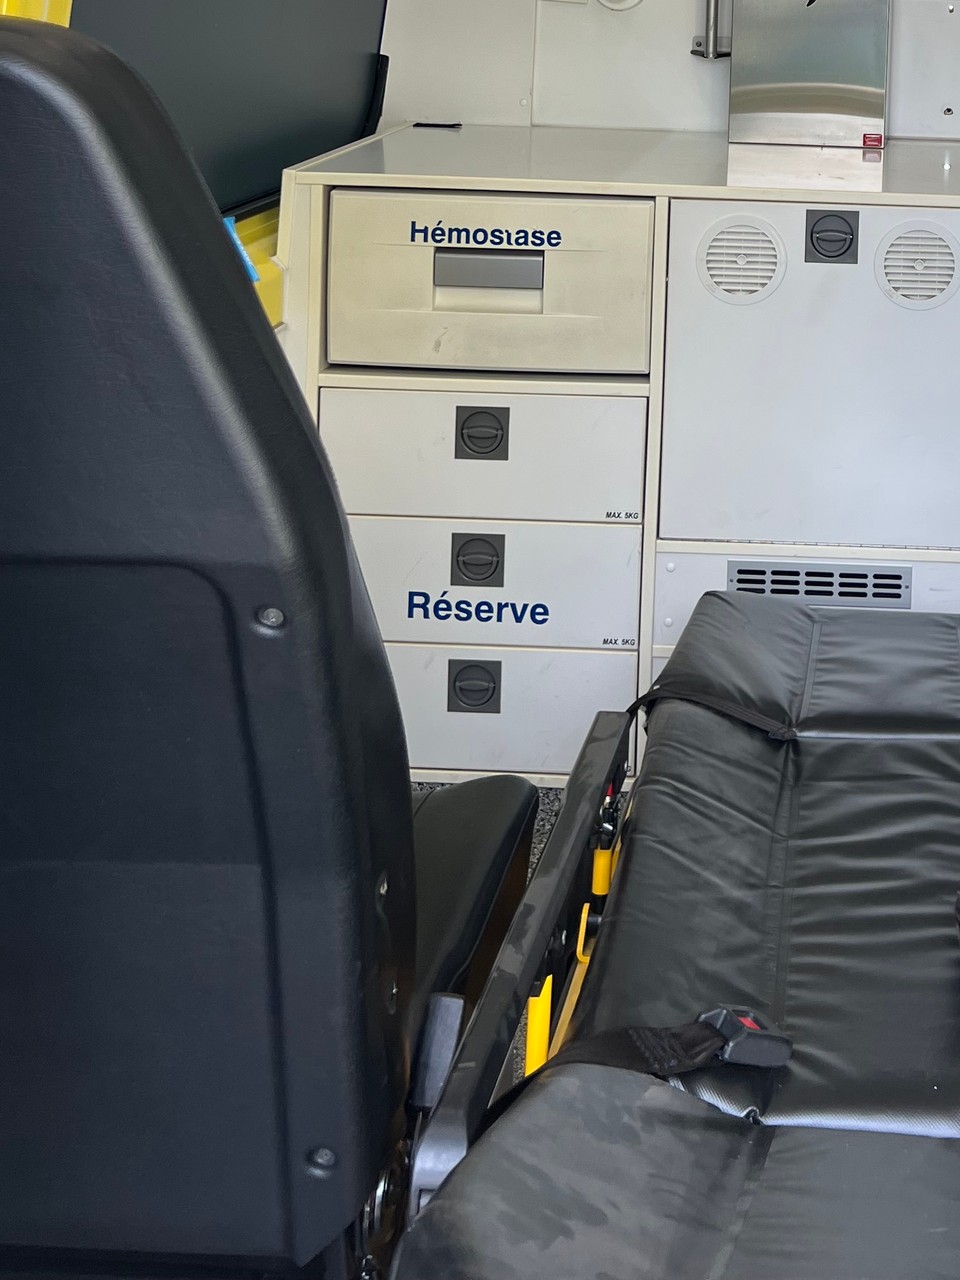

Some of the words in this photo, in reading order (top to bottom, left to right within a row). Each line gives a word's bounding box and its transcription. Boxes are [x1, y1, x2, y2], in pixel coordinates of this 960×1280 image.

[410, 220, 562, 247] Hémostase
[407, 590, 550, 625] Réserve
[621, 638, 636, 646] 5KG
